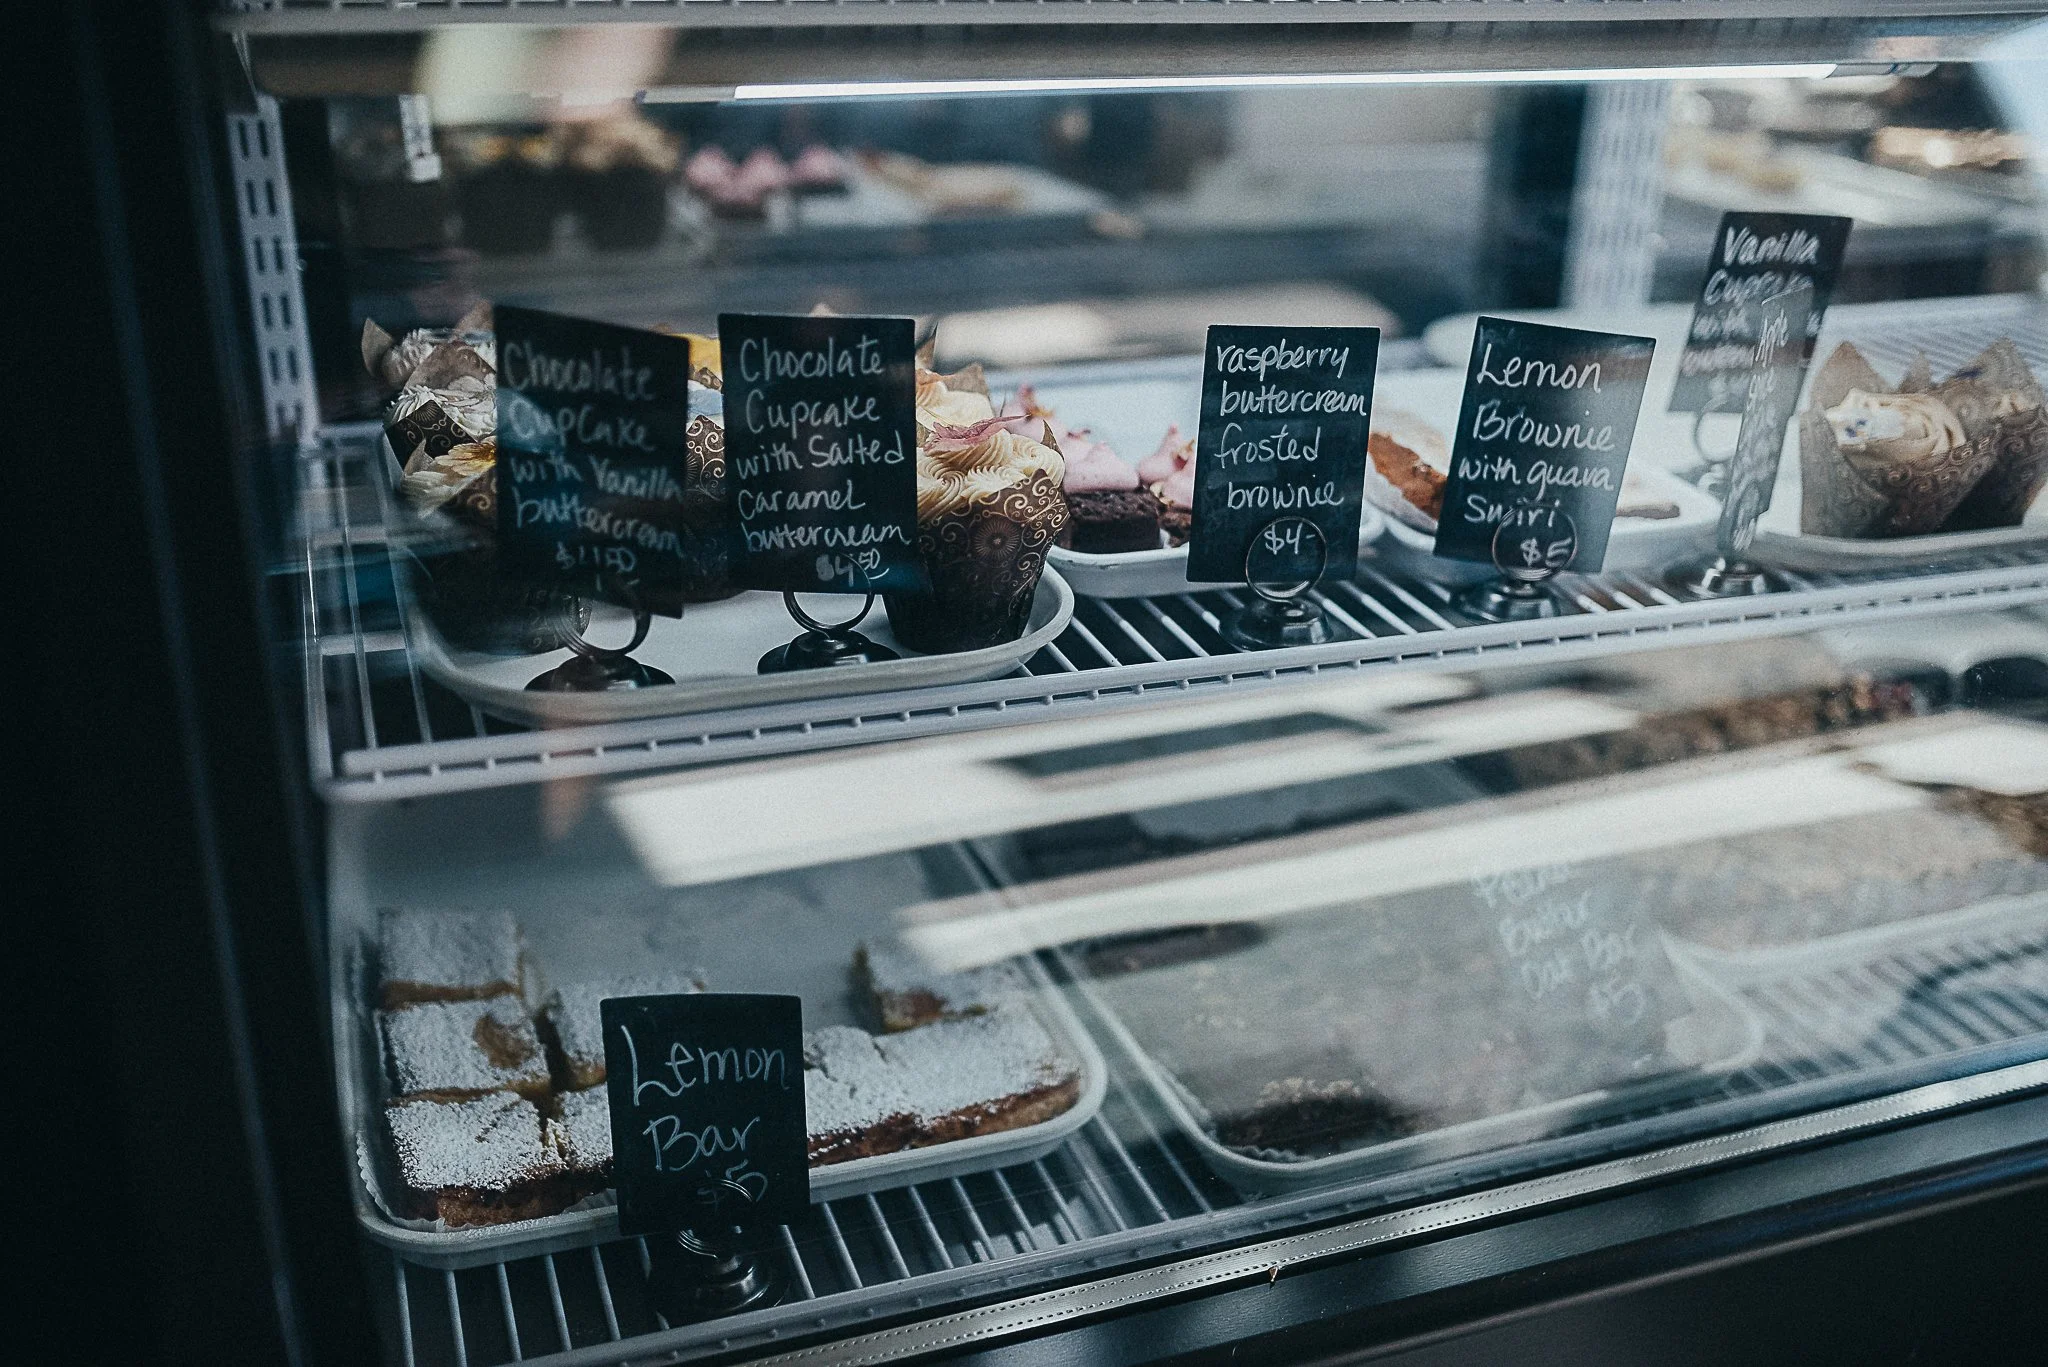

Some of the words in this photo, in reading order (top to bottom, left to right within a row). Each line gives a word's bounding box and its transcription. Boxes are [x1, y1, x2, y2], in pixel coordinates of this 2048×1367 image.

[1724, 226, 1820, 266] Vanilla
[504, 342, 656, 401] Chocolate
[740, 335, 884, 382] Chocolate
[1217, 338, 1350, 381] raspberry
[1476, 343, 1601, 393] Lemon
[746, 388, 880, 439] Cupcake
[1220, 381, 1367, 416] buttercream
[1214, 422, 1321, 468] frosted
[1473, 400, 1615, 450] Brownie
[511, 450, 583, 484] with
[589, 454, 684, 502] Vanilla
[736, 442, 803, 480] with
[808, 431, 904, 467] Salted
[1458, 454, 1521, 485] with
[1527, 460, 1614, 501] guava
[1227, 474, 1344, 509] brownie
[741, 522, 912, 552] buttercream
[1519, 537, 1572, 567] $5
[620, 1024, 791, 1107] Lemon
[642, 1115, 761, 1172] Bar
